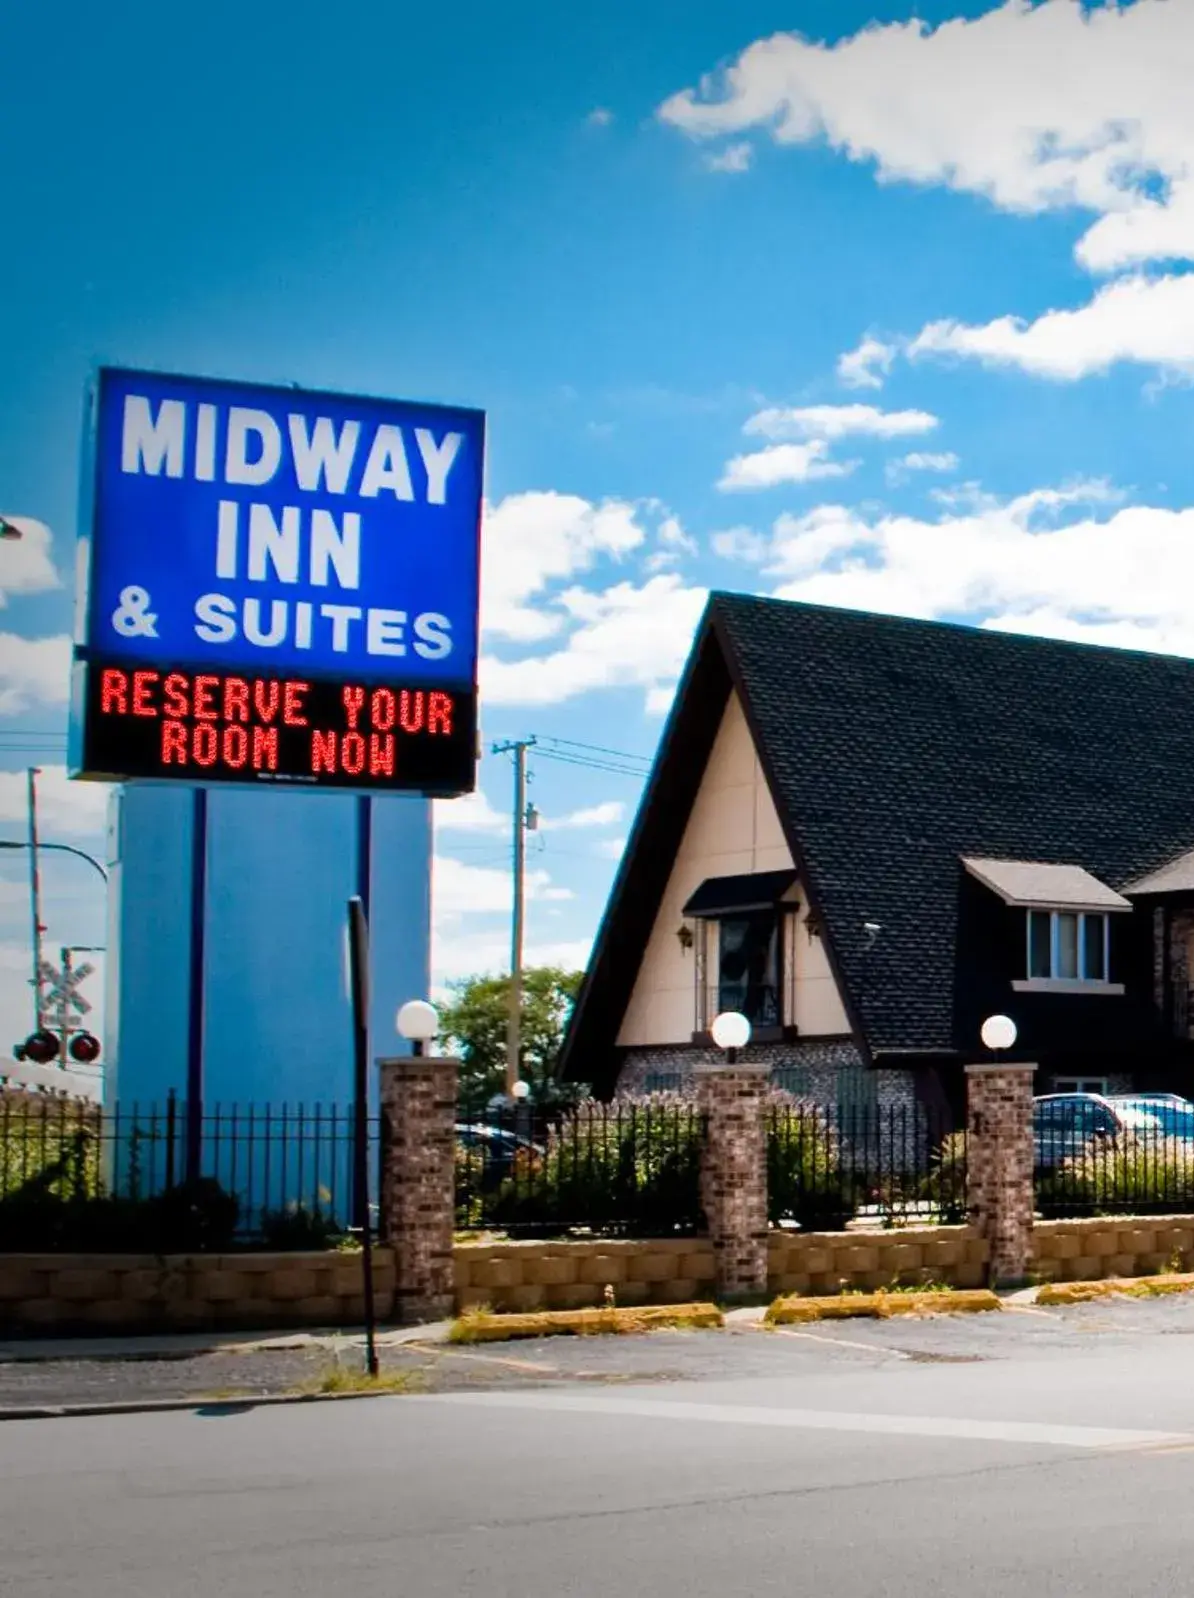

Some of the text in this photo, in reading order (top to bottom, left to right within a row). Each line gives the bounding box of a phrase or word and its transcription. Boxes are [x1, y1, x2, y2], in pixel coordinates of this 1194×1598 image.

[121, 394, 463, 505] MIDWAY
[216, 500, 361, 590] INN
[111, 585, 453, 660] & SUITES
[101, 668, 455, 736] RESERVE YOUR
[161, 720, 397, 777] ROOM NOW
